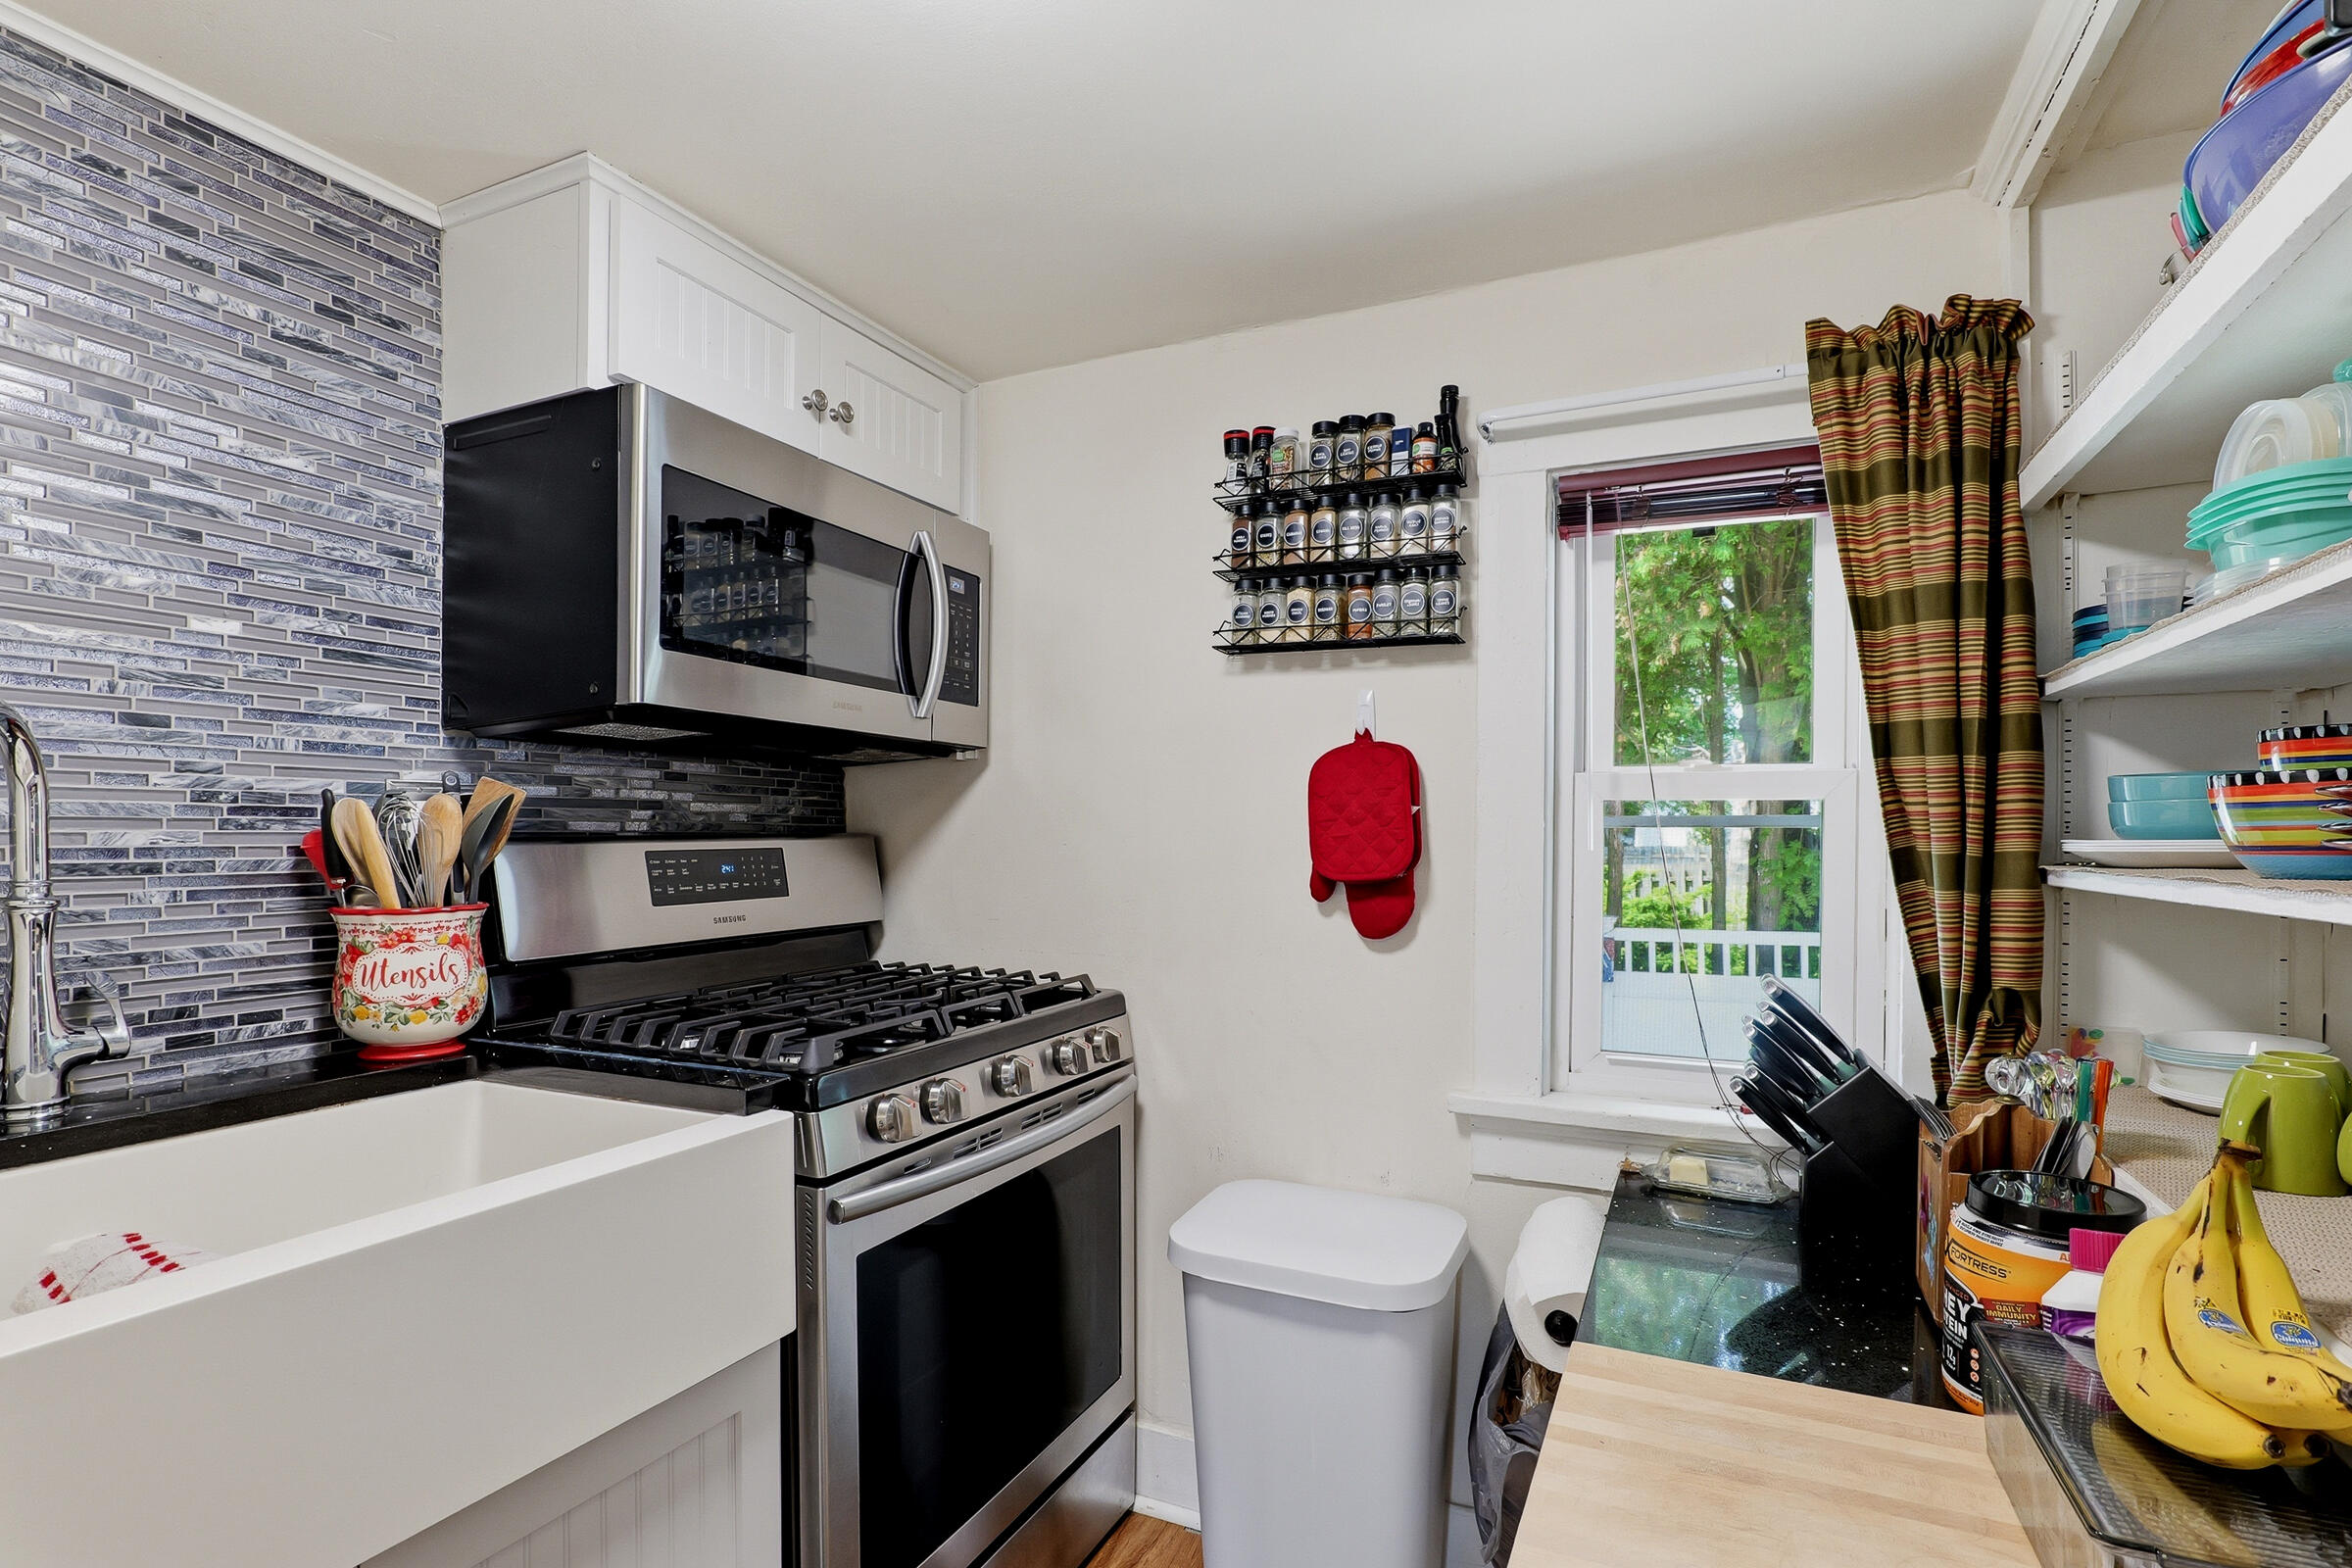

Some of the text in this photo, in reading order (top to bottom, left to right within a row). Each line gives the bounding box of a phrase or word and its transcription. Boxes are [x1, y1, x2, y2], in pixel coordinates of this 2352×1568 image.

[712, 914, 747, 924] SAMSUNG
[359, 952, 462, 992] Utensils
[1950, 1246, 2007, 1279] FORTRESS
[1995, 1304, 2023, 1313] DAILY
[1985, 1309, 2036, 1321] IMMUNITY
